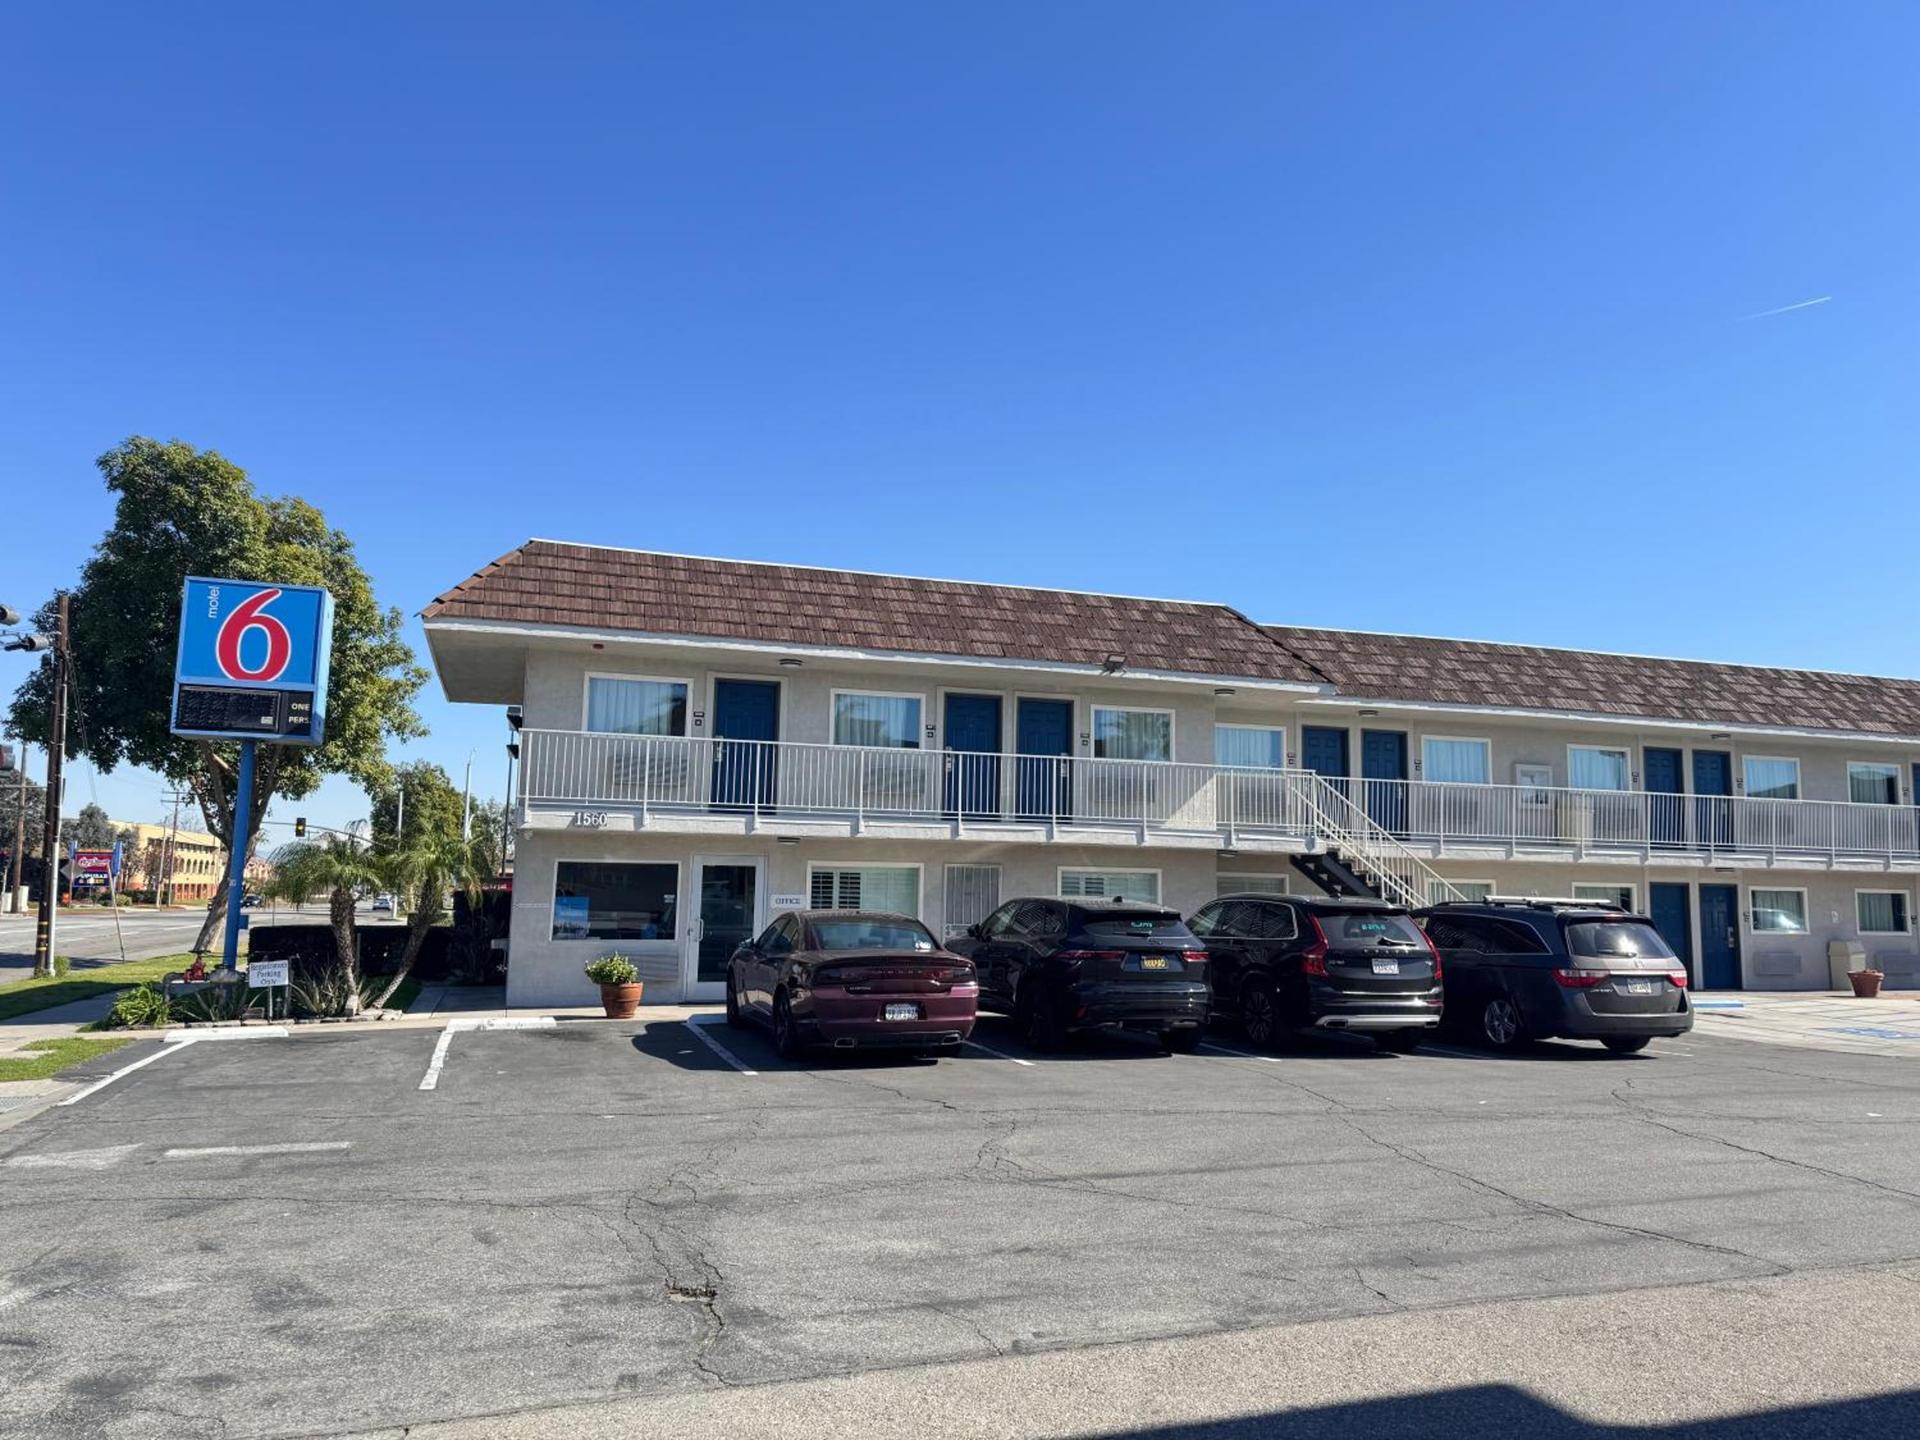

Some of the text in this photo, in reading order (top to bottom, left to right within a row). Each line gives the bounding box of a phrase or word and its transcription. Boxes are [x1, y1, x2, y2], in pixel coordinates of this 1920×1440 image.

[208, 586, 292, 681] motel 6
[291, 702, 310, 711] ONE
[575, 812, 608, 826] 1560
